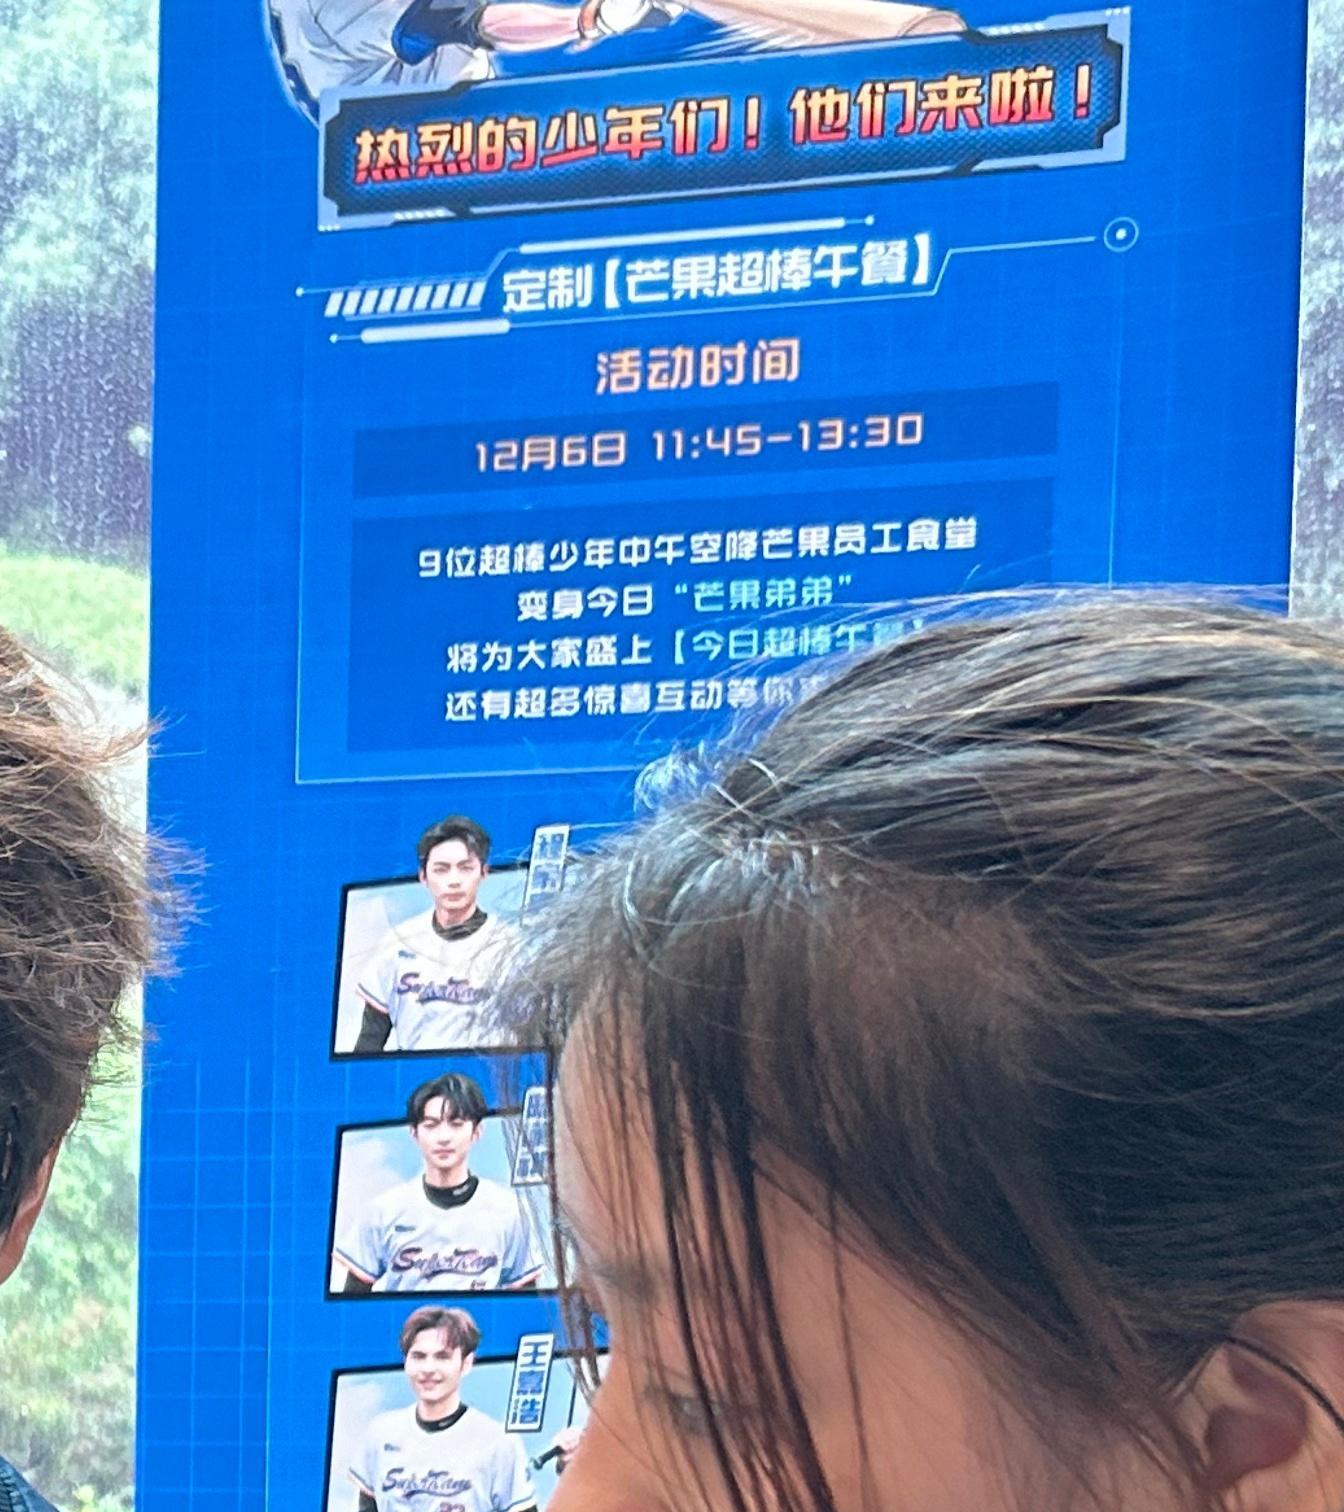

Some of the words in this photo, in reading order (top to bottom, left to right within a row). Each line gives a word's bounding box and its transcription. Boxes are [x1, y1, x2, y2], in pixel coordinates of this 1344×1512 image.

[501, 233, 931, 315] 定制【芒果超棒午餐】
[595, 337, 800, 395] 活动时间
[474, 431, 627, 472] 12月6日
[653, 412, 925, 459] 11:45-13:30
[418, 516, 979, 579] 9位超棒少年中午空降芒果员工食堂
